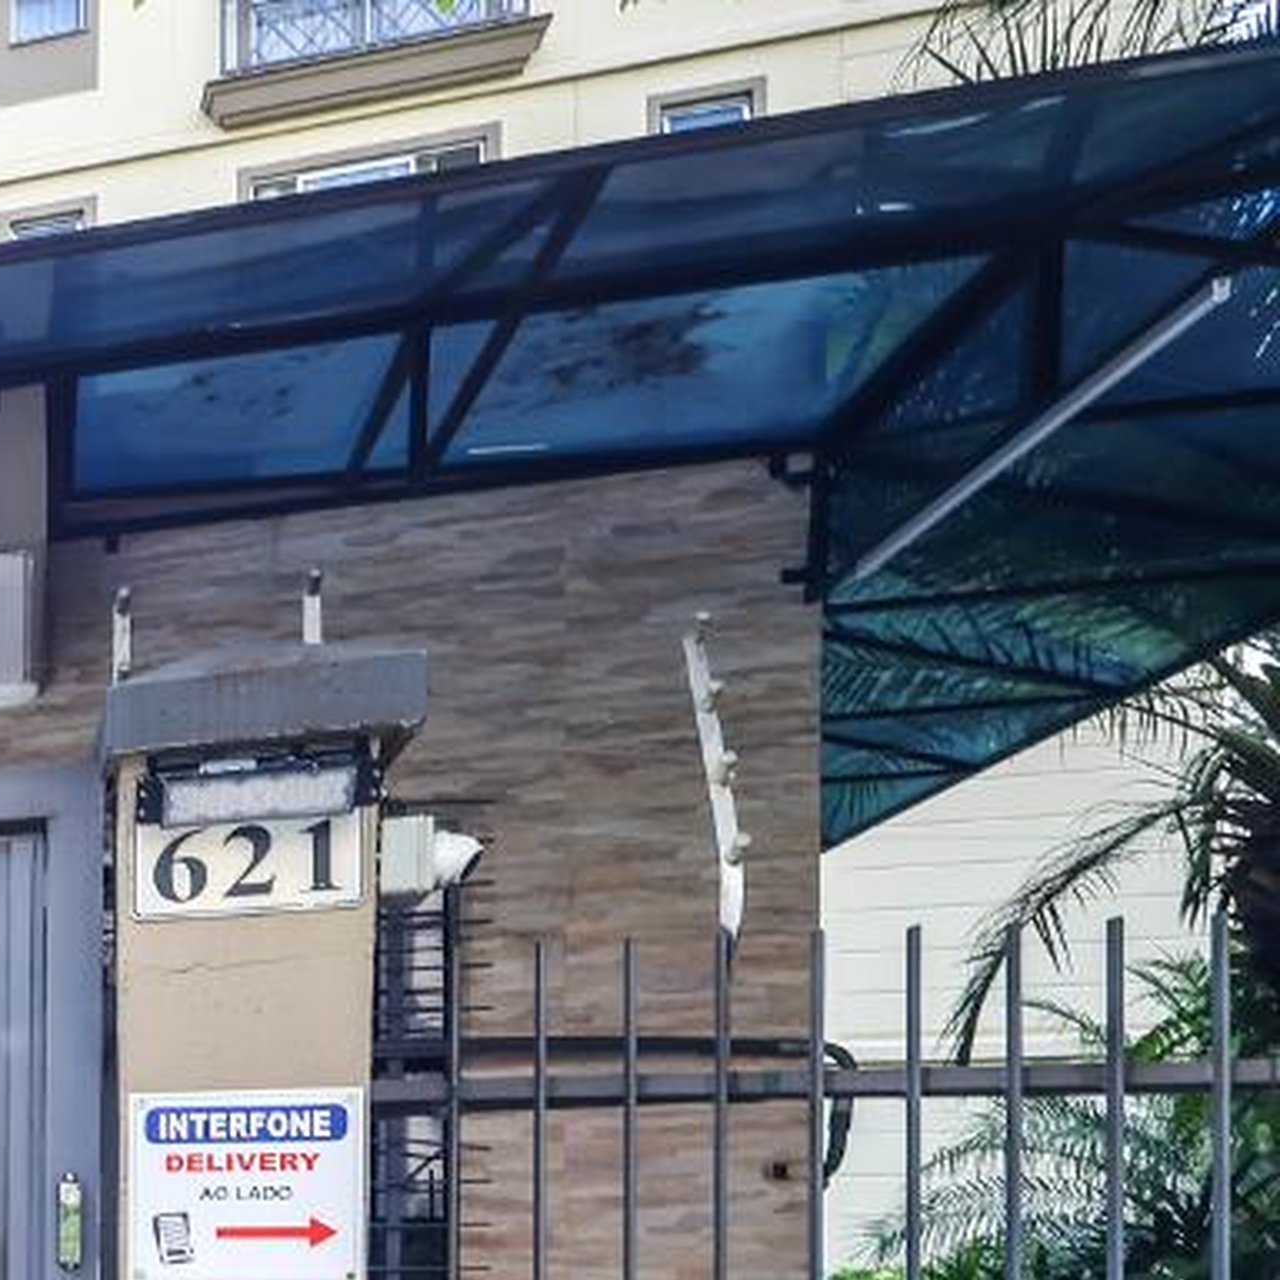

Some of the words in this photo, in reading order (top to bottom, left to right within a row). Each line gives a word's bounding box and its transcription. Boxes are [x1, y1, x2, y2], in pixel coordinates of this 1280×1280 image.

[153, 818, 342, 903] 621
[159, 1109, 332, 1140] INTERFONE
[165, 1153, 320, 1172] DELIVERY
[199, 1185, 227, 1201] AO
[236, 1185, 293, 1201] LADO
